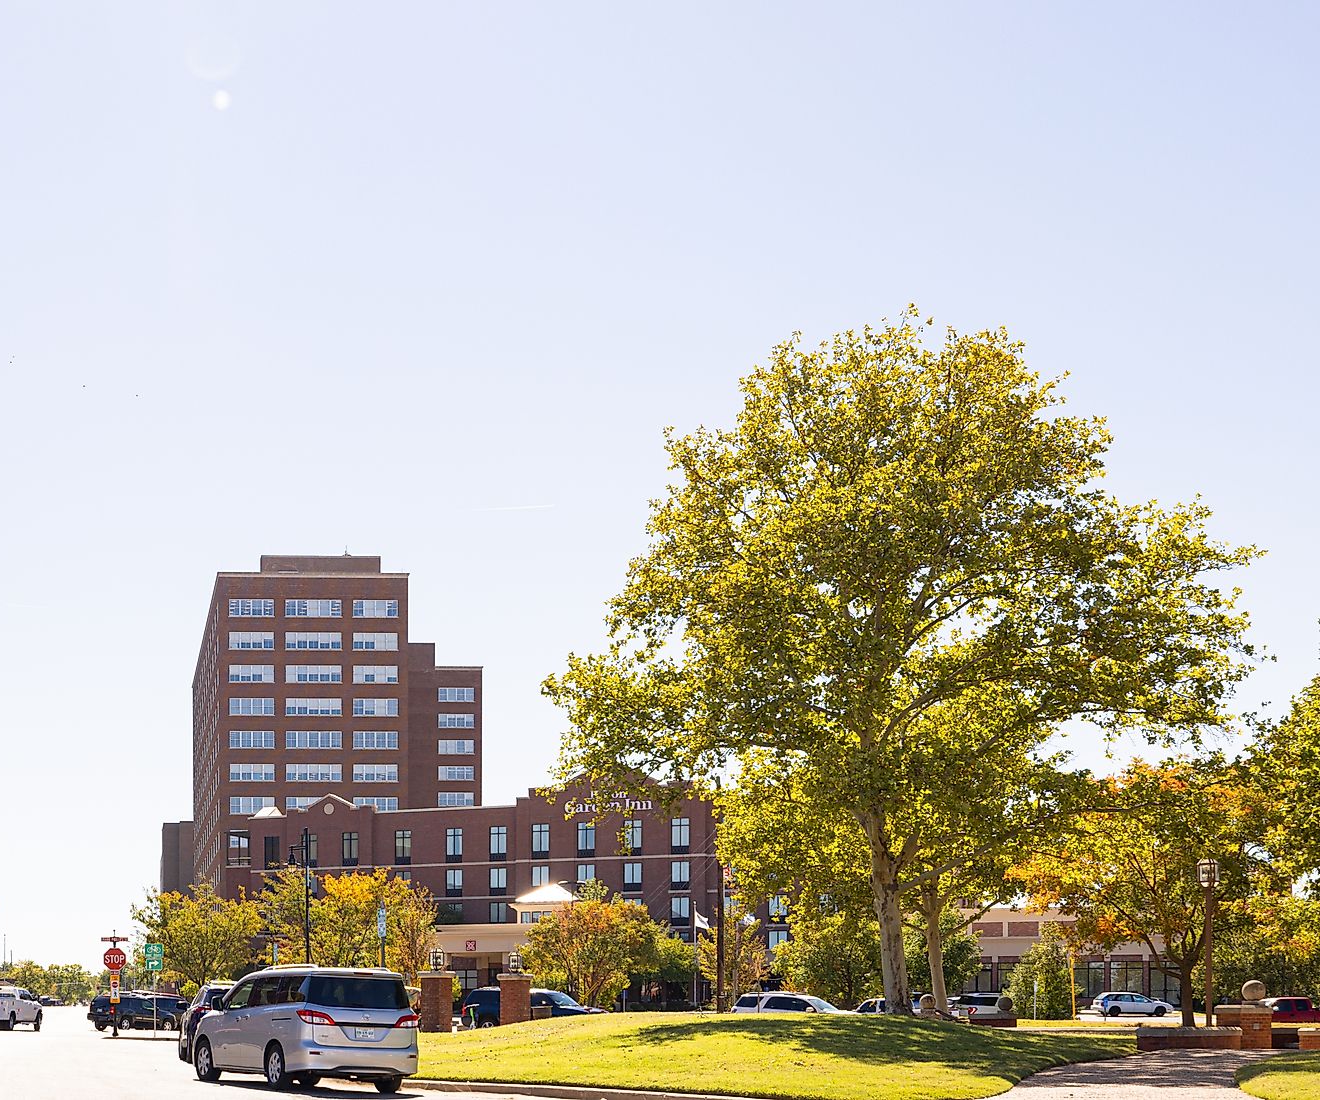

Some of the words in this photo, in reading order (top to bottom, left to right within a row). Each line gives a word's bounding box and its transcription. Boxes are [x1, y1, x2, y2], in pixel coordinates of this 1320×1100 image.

[589, 790, 627, 799] Hon
[625, 798, 653, 811] Inn
[104, 954, 125, 964] STOP
